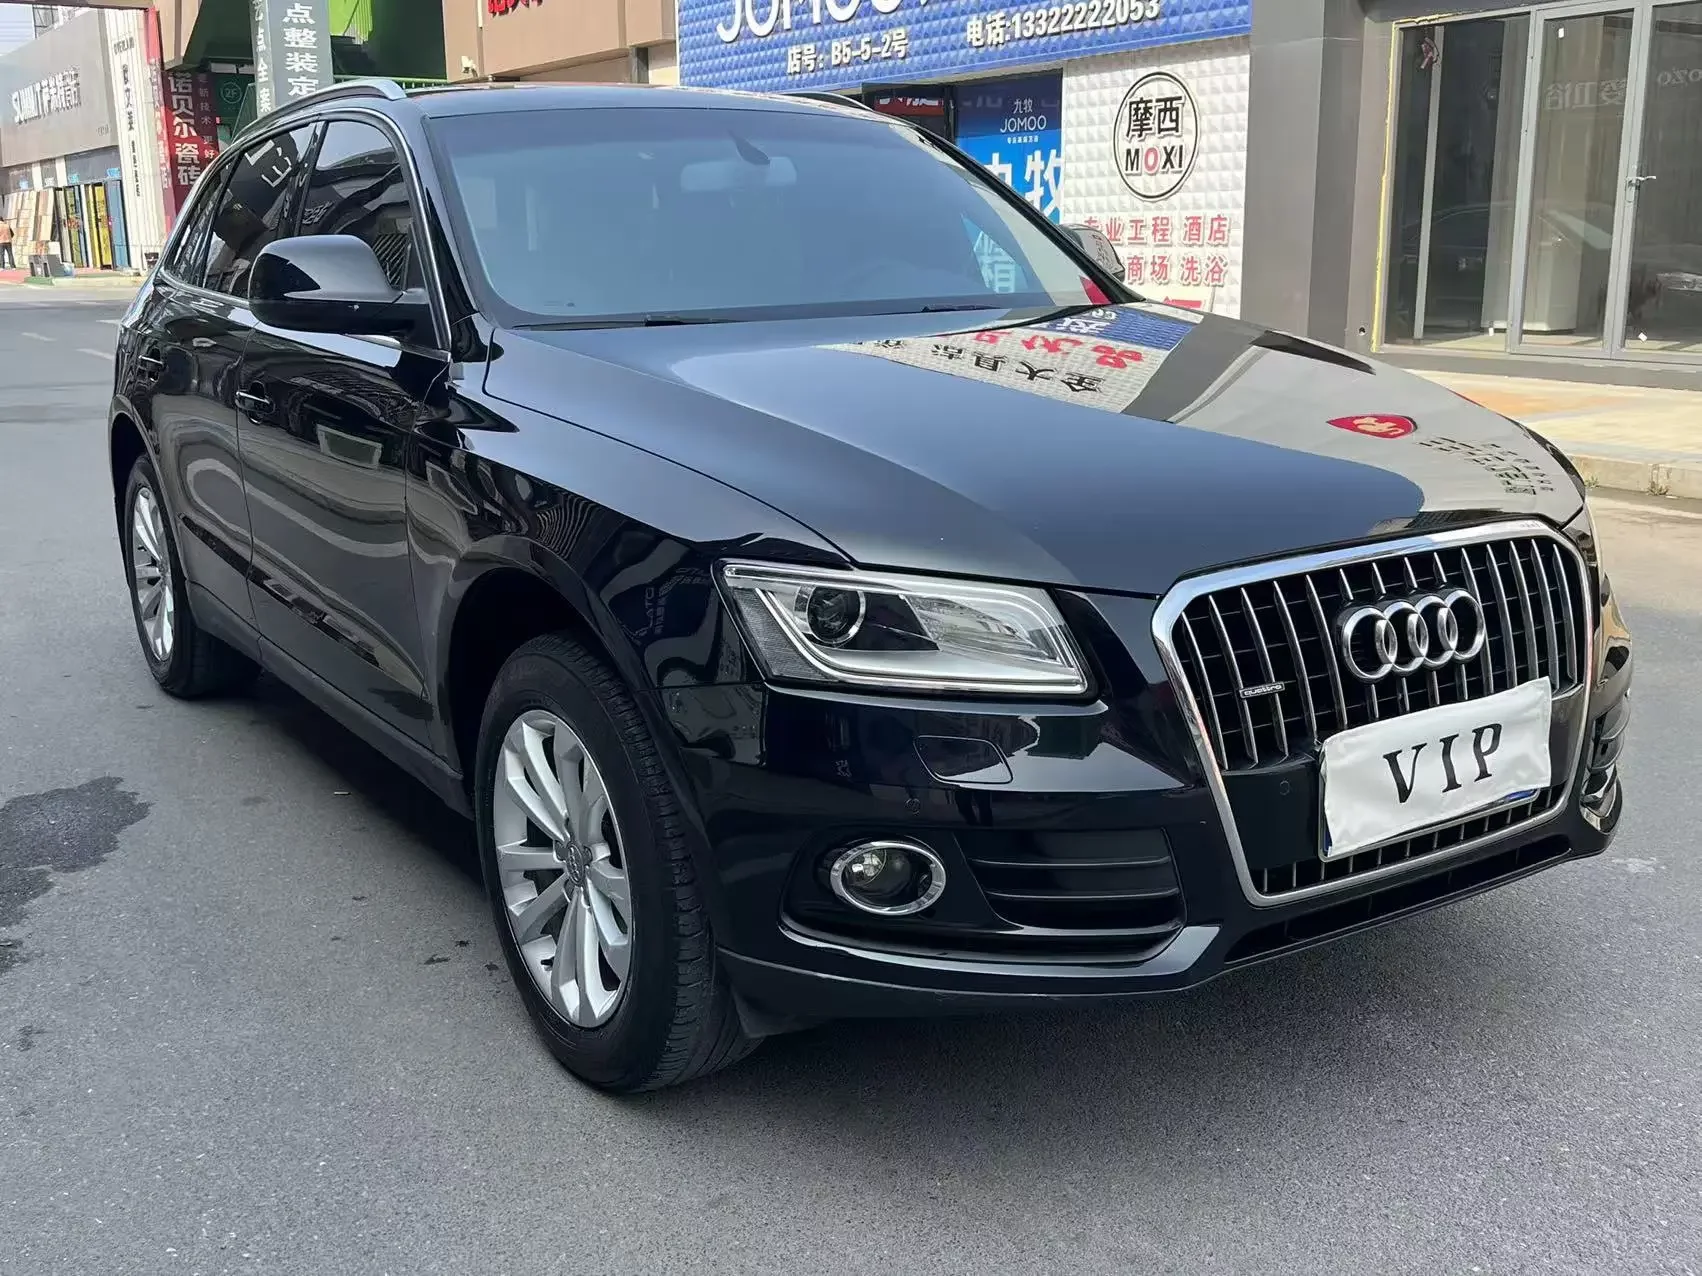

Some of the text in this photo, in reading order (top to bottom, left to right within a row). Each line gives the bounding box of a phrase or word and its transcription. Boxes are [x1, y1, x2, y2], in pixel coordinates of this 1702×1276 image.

[282, 3, 319, 96] 点整装定
[1013, 97, 1033, 114] 九牧
[1126, 96, 1183, 138] 摩西
[168, 72, 201, 185] 诺贝尔瓷砖
[1000, 115, 1047, 133] JOMOO
[1125, 145, 1184, 172] MOXI
[1182, 214, 1229, 242] 酒店
[1127, 254, 1228, 283] 商场 洗浴
[1243, 684, 1282, 697] quattro
[1382, 723, 1502, 804] VIP
